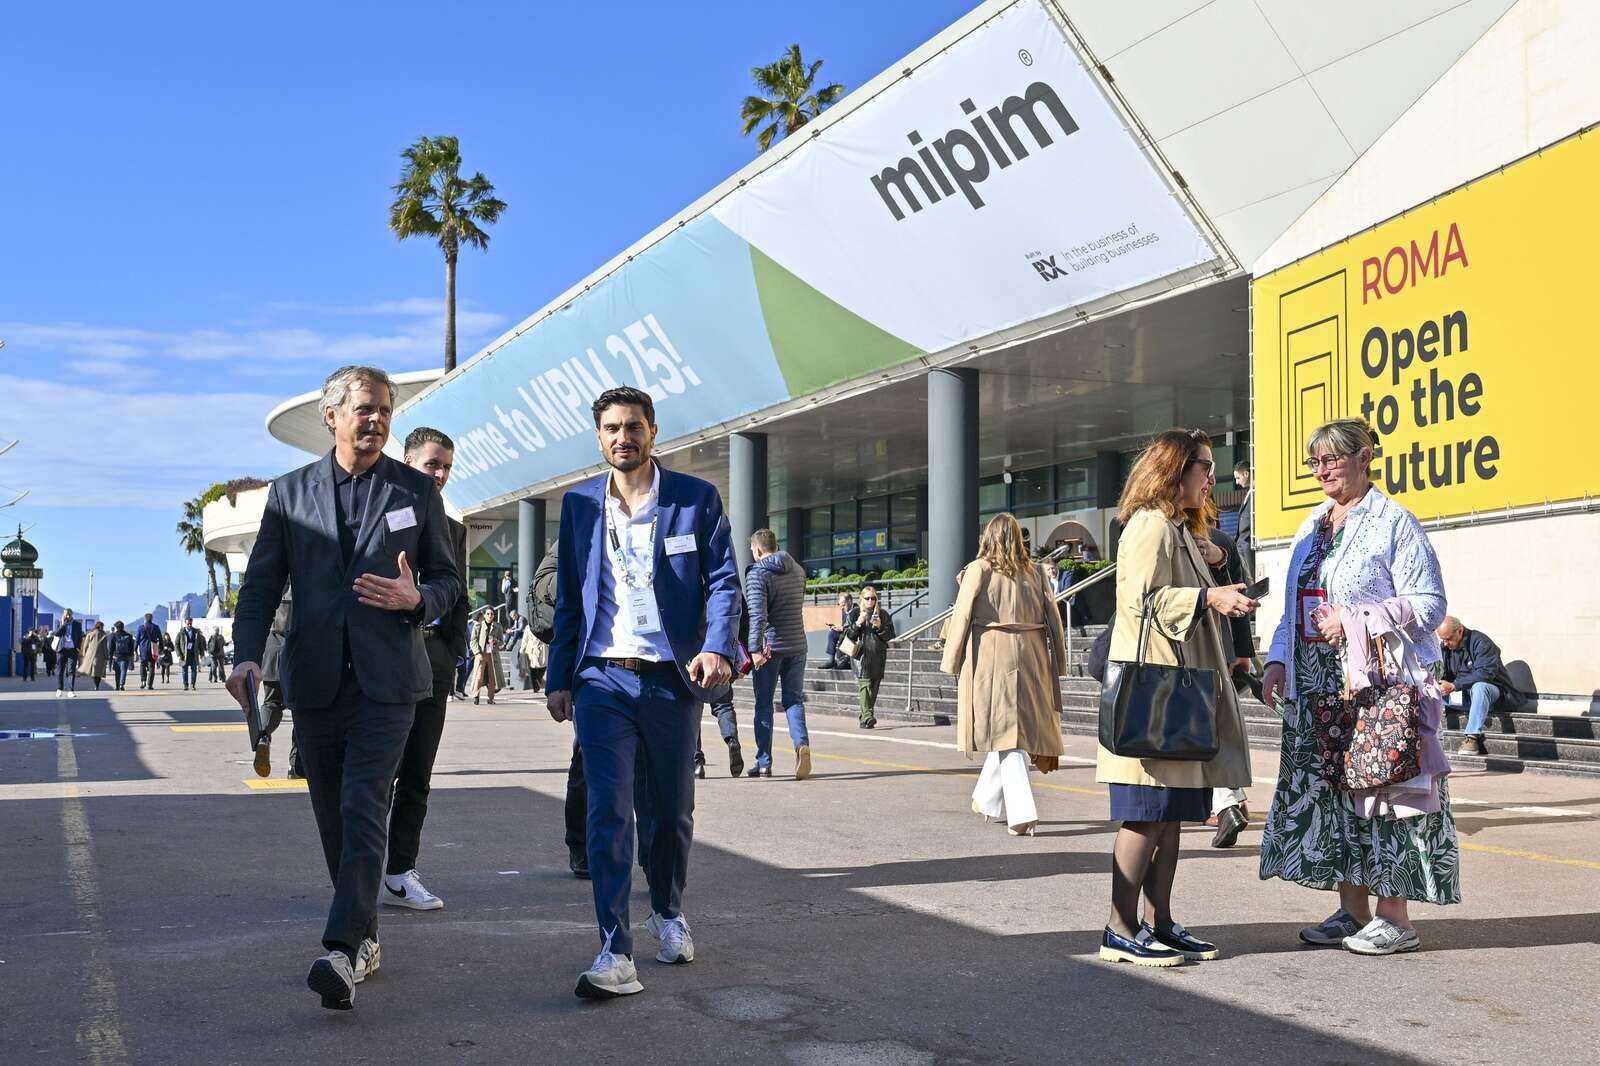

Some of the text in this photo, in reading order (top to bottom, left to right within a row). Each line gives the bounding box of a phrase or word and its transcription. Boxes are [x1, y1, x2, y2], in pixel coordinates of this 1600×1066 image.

[869, 81, 1080, 221] mipim
[1031, 255, 1069, 282] RX
[1070, 232, 1160, 272] building businesses
[1071, 245, 1089, 259] the
[1087, 229, 1129, 252] business
[1127, 222, 1139, 236] of
[1361, 221, 1469, 305] ROMA
[494, 402, 546, 453] to
[605, 313, 703, 404] 25!
[1360, 309, 1469, 386] Open
[1360, 367, 1484, 436] to the
